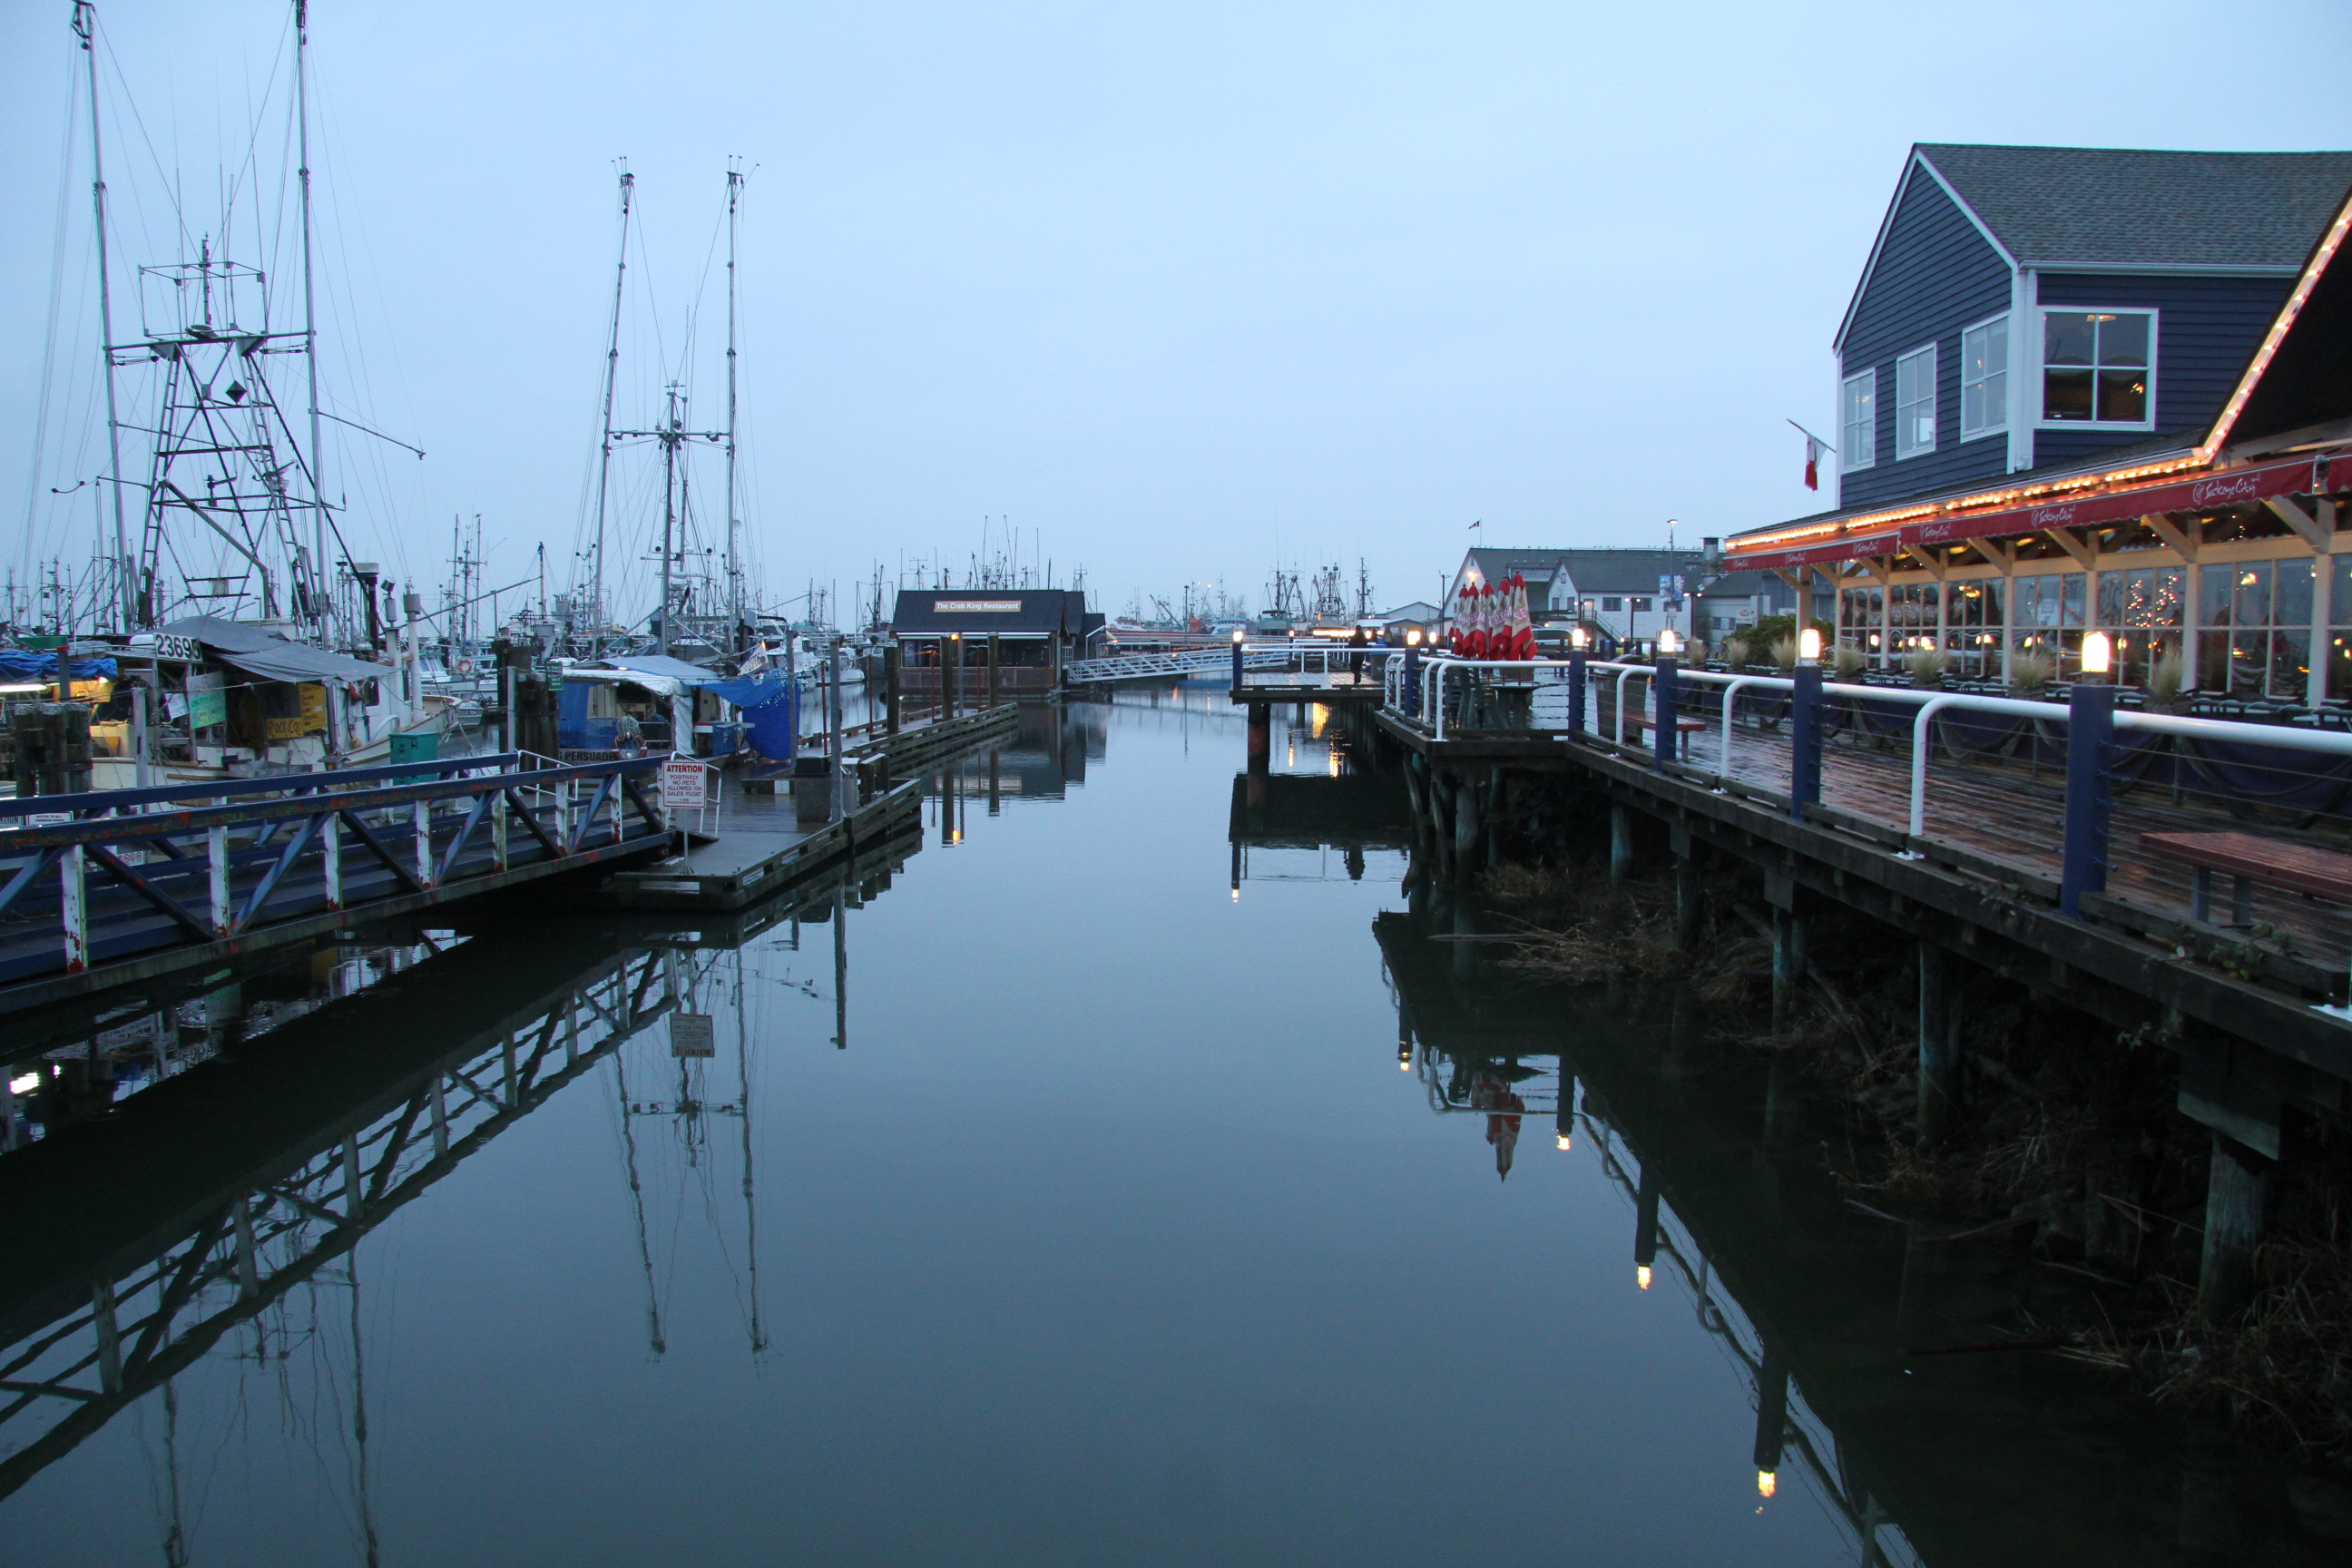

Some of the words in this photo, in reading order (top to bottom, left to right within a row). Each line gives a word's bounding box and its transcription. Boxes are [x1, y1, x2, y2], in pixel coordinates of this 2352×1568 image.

[966, 603, 982, 611] King
[156, 633, 201, 661] 23695
[666, 764, 703, 773] ATTENTION
